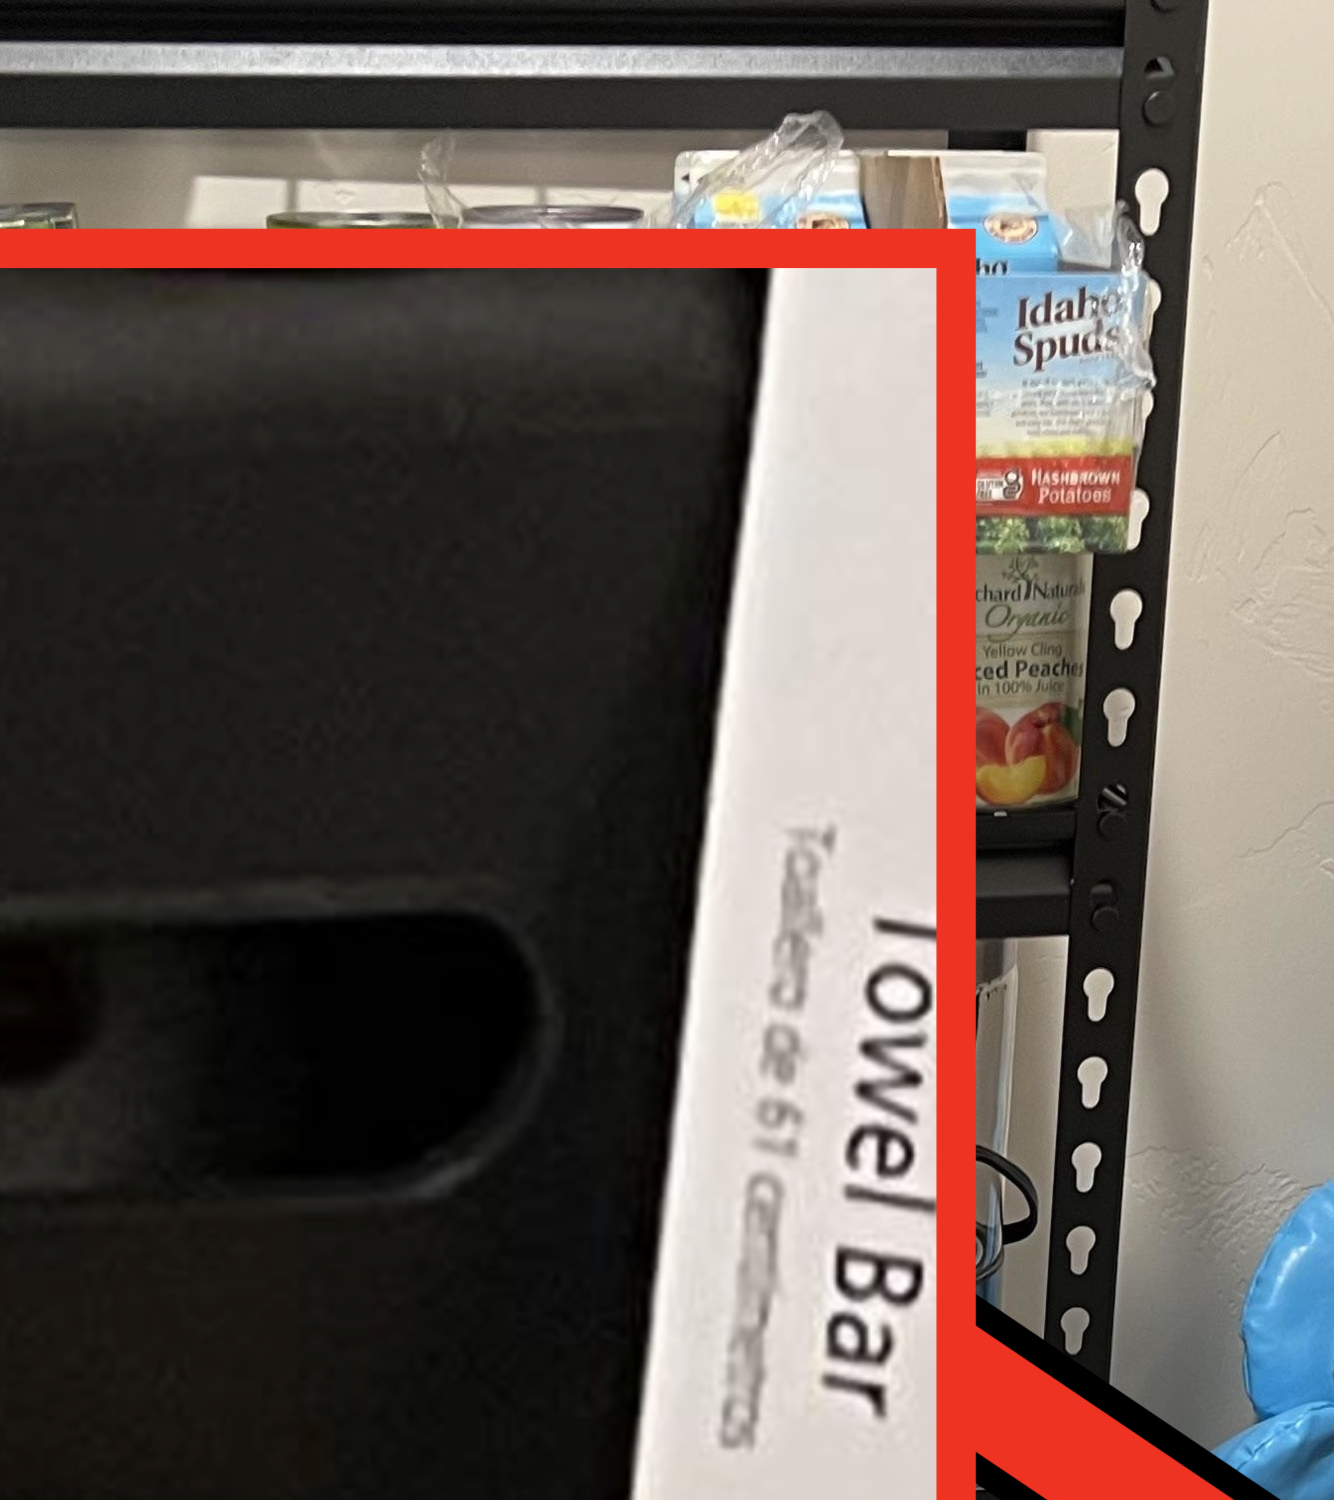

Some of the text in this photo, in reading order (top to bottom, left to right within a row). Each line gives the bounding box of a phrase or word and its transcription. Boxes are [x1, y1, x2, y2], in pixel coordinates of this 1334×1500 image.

[1013, 320, 1120, 372] Spuds
[1032, 468, 1120, 487] HASHBROWN
[1038, 487, 1112, 504] Potatoes
[985, 603, 1069, 643] Organic
[983, 641, 1063, 659] Yellow Cling
[1016, 657, 1084, 678] Peaches
[1036, 678, 1065, 692] Juice
[822, 1245, 924, 1419] Bar
